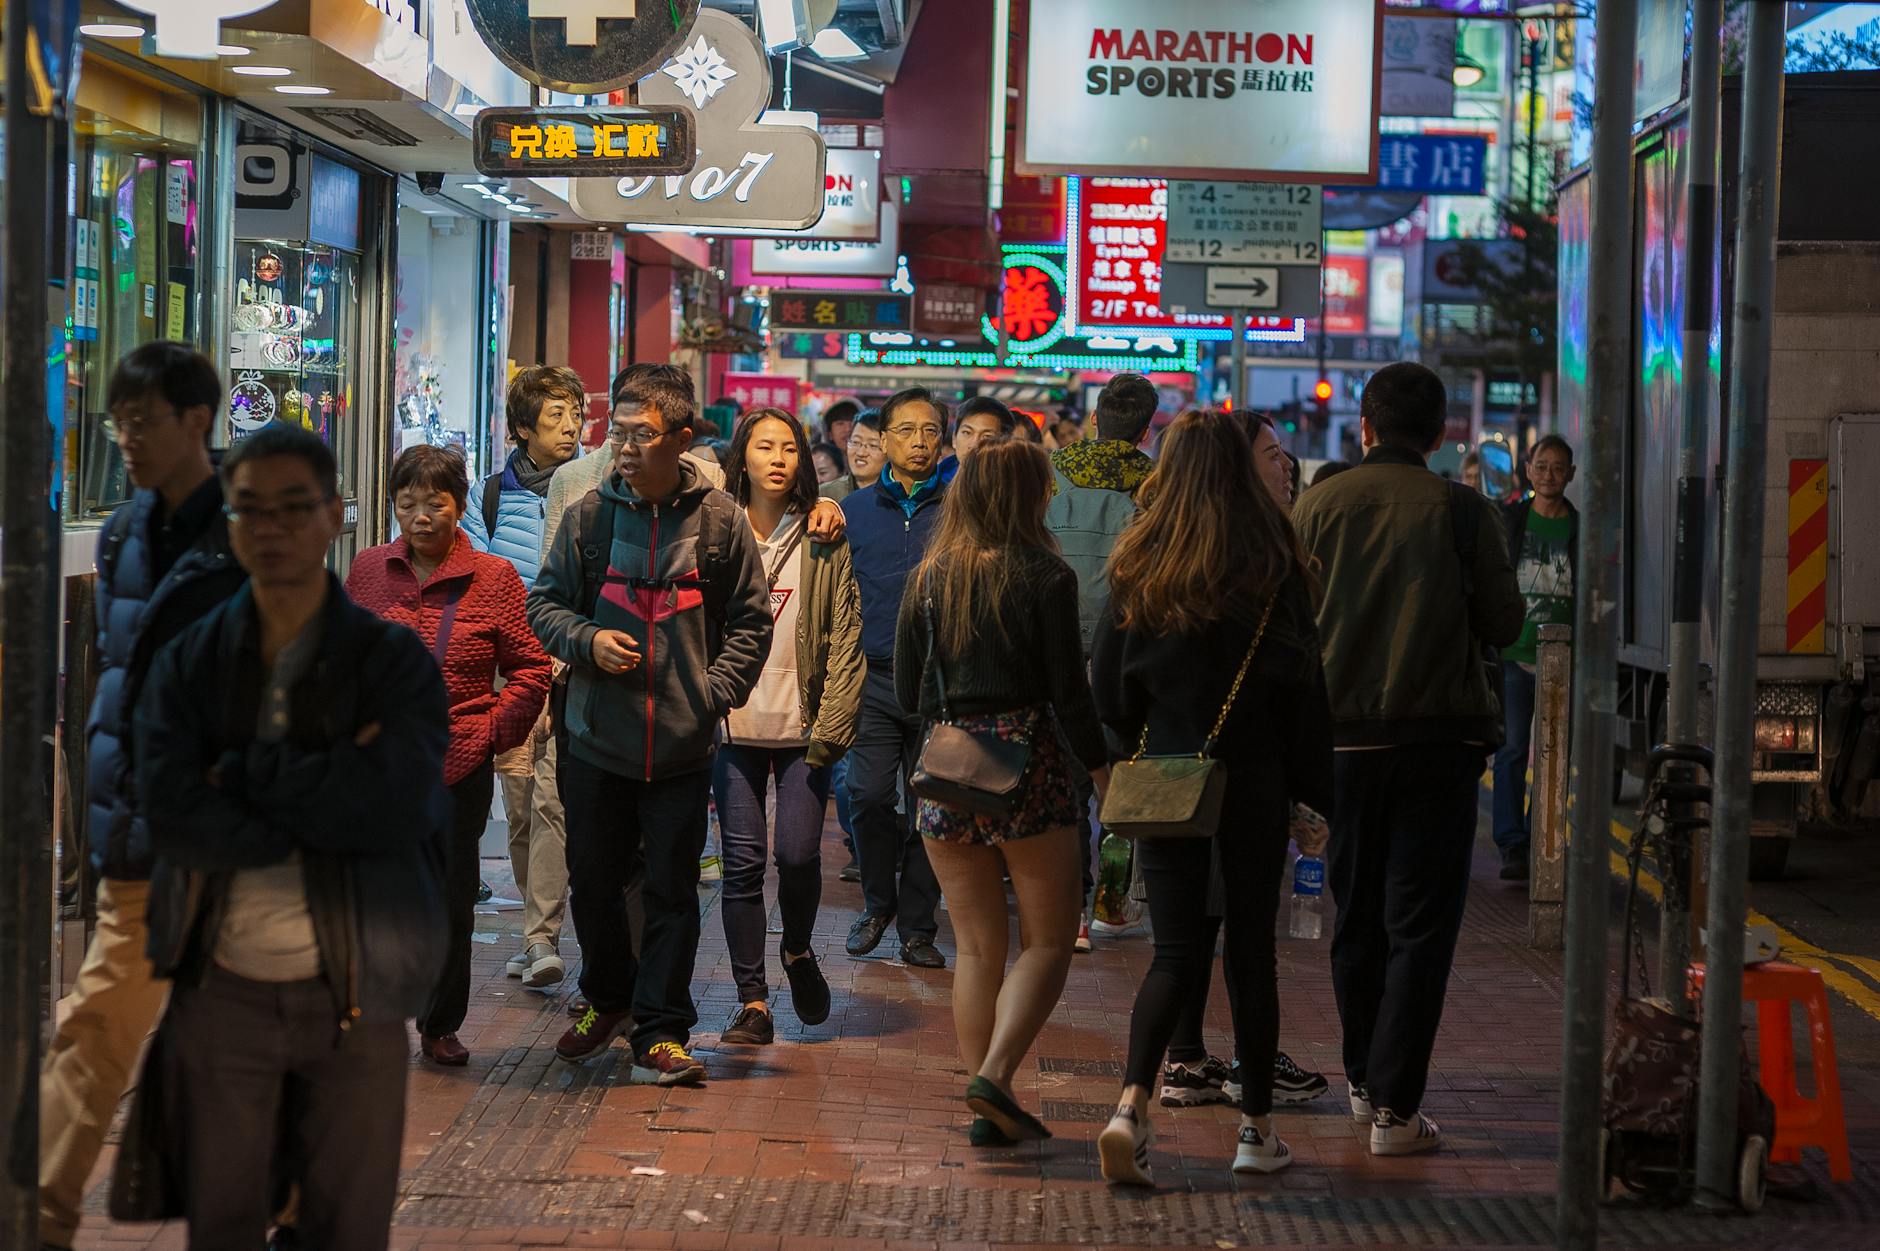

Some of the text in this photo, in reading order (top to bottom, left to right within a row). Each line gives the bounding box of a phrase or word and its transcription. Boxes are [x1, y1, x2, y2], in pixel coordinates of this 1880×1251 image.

[1089, 28, 1314, 65] MARATHON
[1087, 65, 1236, 99] SPORTS
[1241, 69, 1314, 92] 馬拉松
[592, 123, 660, 157] 汇款
[1201, 185, 1216, 203] 4
[1237, 183, 1285, 193] midnight
[1288, 186, 1312, 204] 12
[1198, 239, 1222, 257] 12
[1243, 237, 1291, 248] midnight
[1294, 242, 1317, 260] 12
[1091, 299, 1128, 318] 2/F
